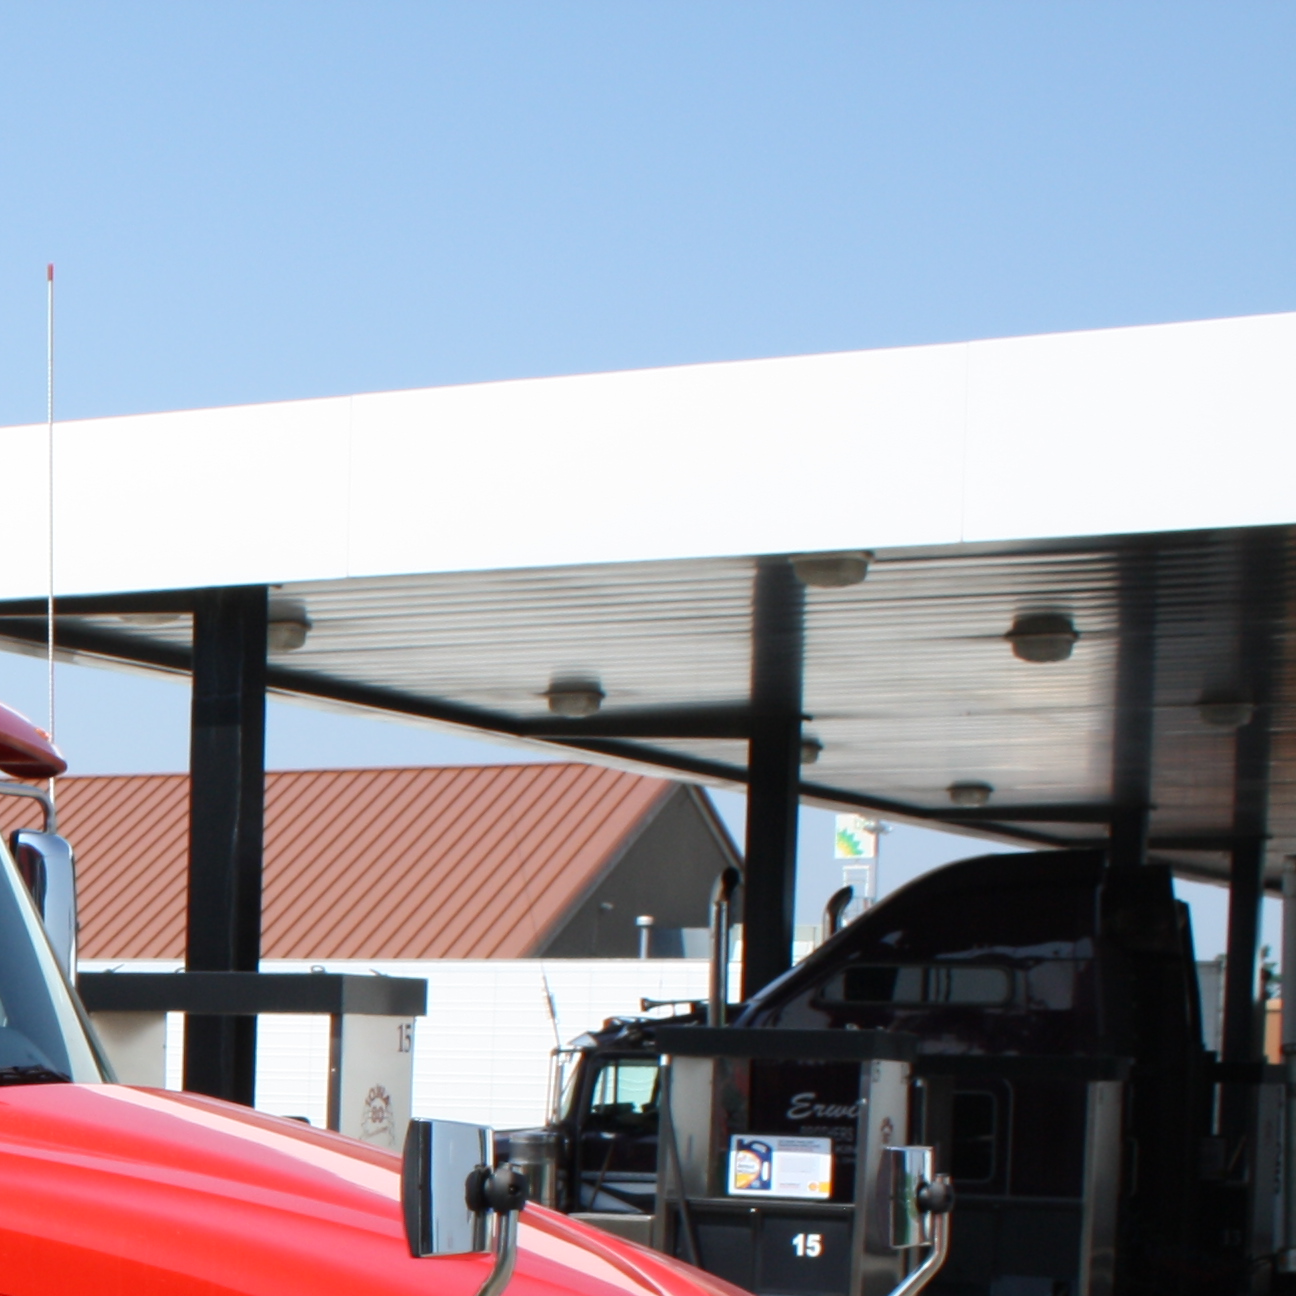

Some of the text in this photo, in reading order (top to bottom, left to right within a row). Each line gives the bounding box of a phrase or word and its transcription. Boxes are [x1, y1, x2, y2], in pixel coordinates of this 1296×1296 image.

[398, 1023, 412, 1053] 15
[786, 1092, 864, 1120] Erwi
[791, 1233, 822, 1257] 15
